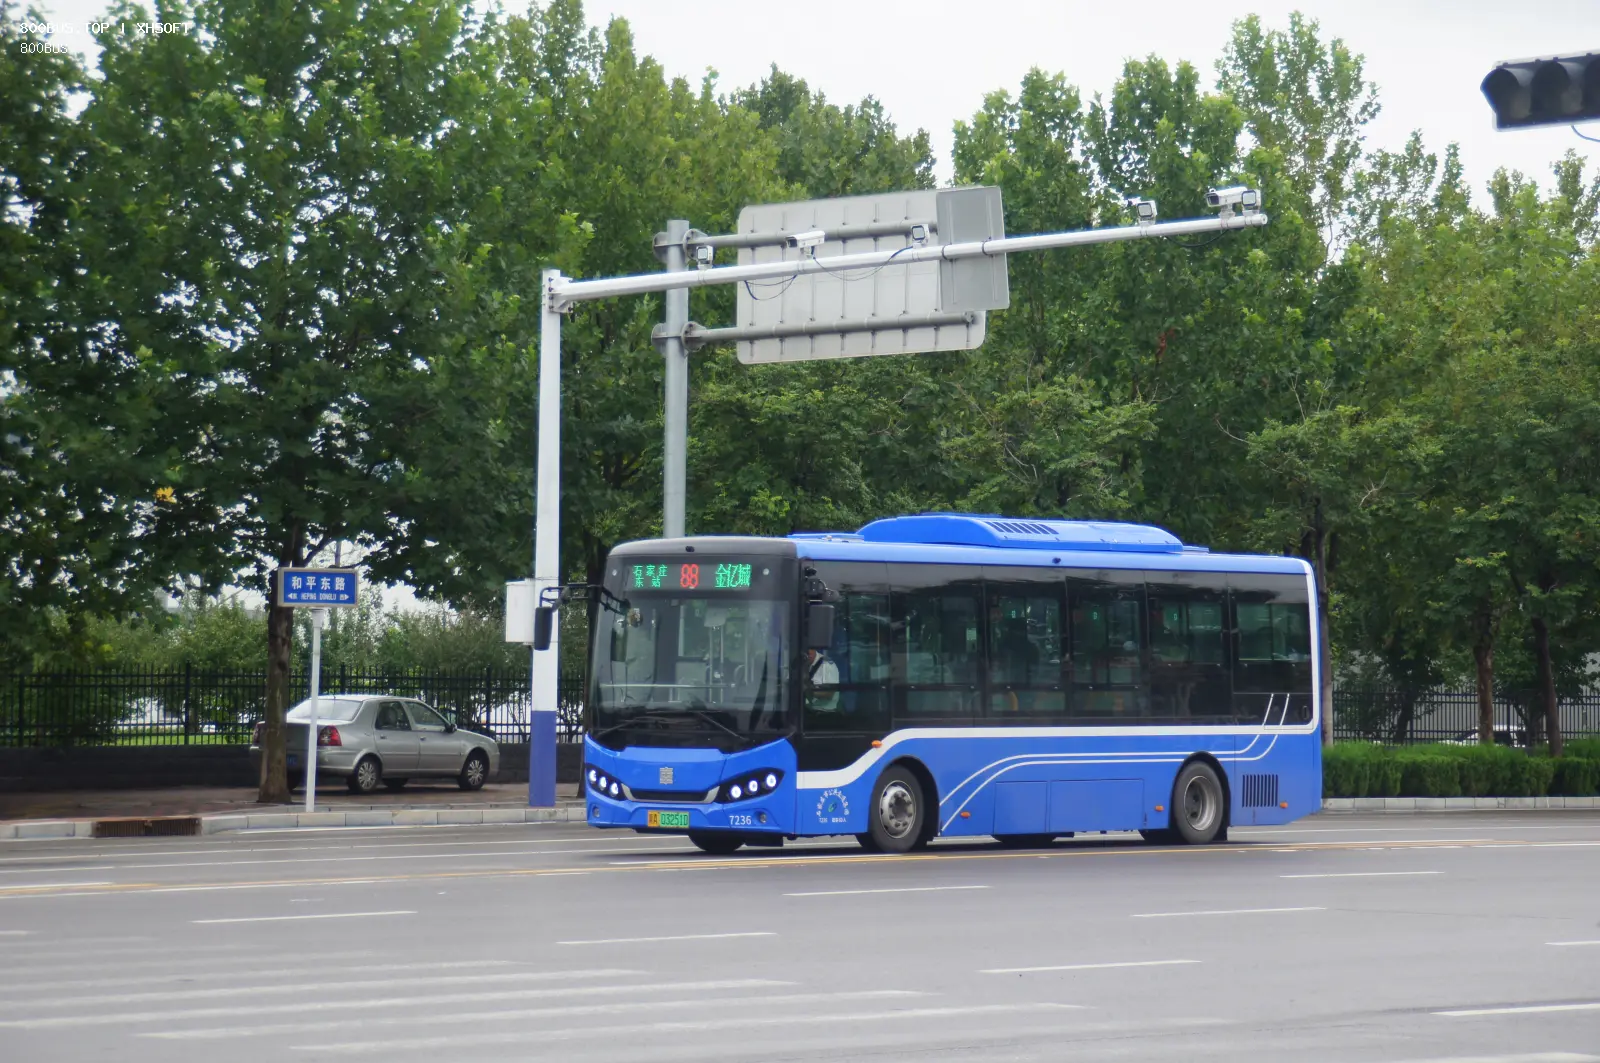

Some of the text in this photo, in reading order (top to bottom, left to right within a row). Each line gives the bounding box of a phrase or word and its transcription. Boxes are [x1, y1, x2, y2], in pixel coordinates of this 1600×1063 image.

[633, 564, 668, 577] 石家庄
[680, 563, 700, 588] 88
[715, 563, 752, 588] 金亿城
[291, 575, 346, 591] 和平东路
[635, 576, 661, 588] 东站
[729, 815, 752, 826] 7236
